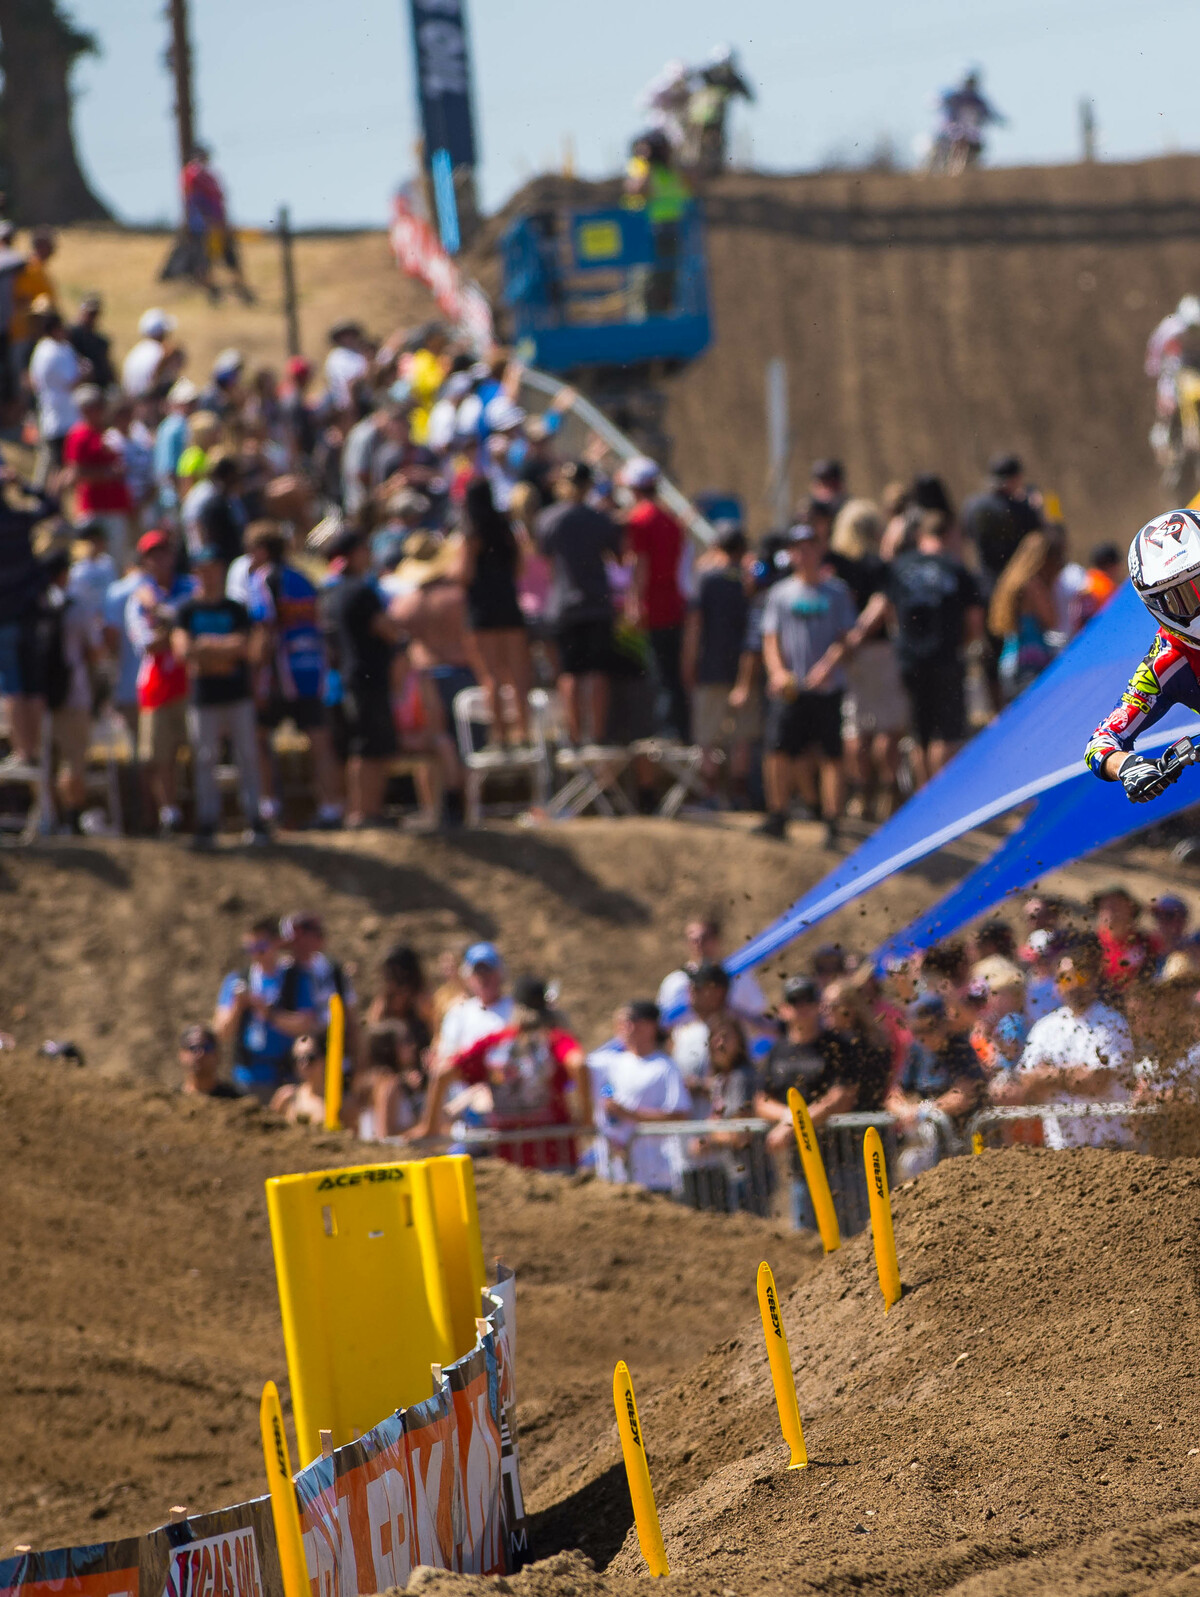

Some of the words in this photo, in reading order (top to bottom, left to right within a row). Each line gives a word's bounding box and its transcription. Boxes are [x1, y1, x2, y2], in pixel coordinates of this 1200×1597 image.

[1121, 691, 1151, 715] EICO
[1127, 685, 1154, 705] ONDA
[317, 1168, 404, 1192] ACERBIS
[872, 1151, 885, 1199] ACERBIS
[766, 1286, 782, 1339] ACERBIS
[625, 1389, 641, 1447] ACERBIS
